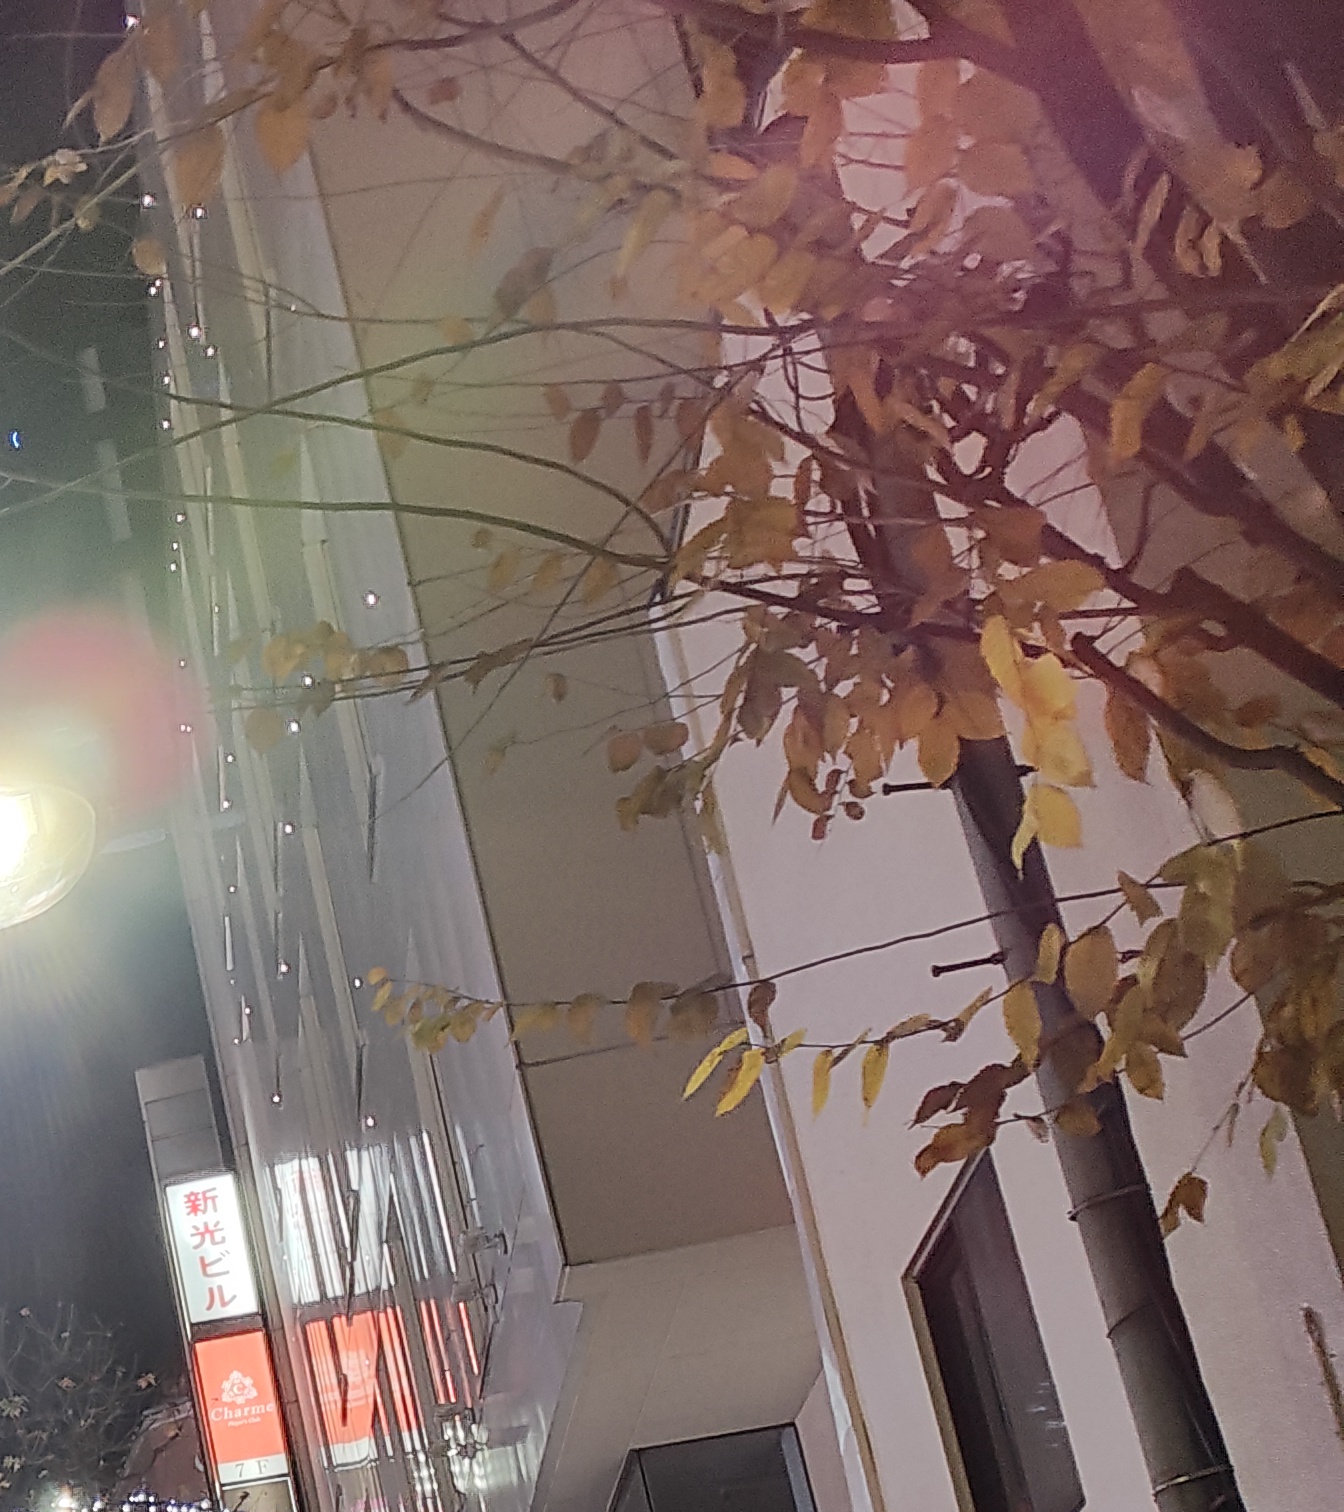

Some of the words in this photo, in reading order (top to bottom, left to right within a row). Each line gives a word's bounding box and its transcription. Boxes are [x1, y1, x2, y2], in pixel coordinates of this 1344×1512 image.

[182, 1187, 238, 1312] 新光ビル
[210, 1403, 275, 1423] Charme
